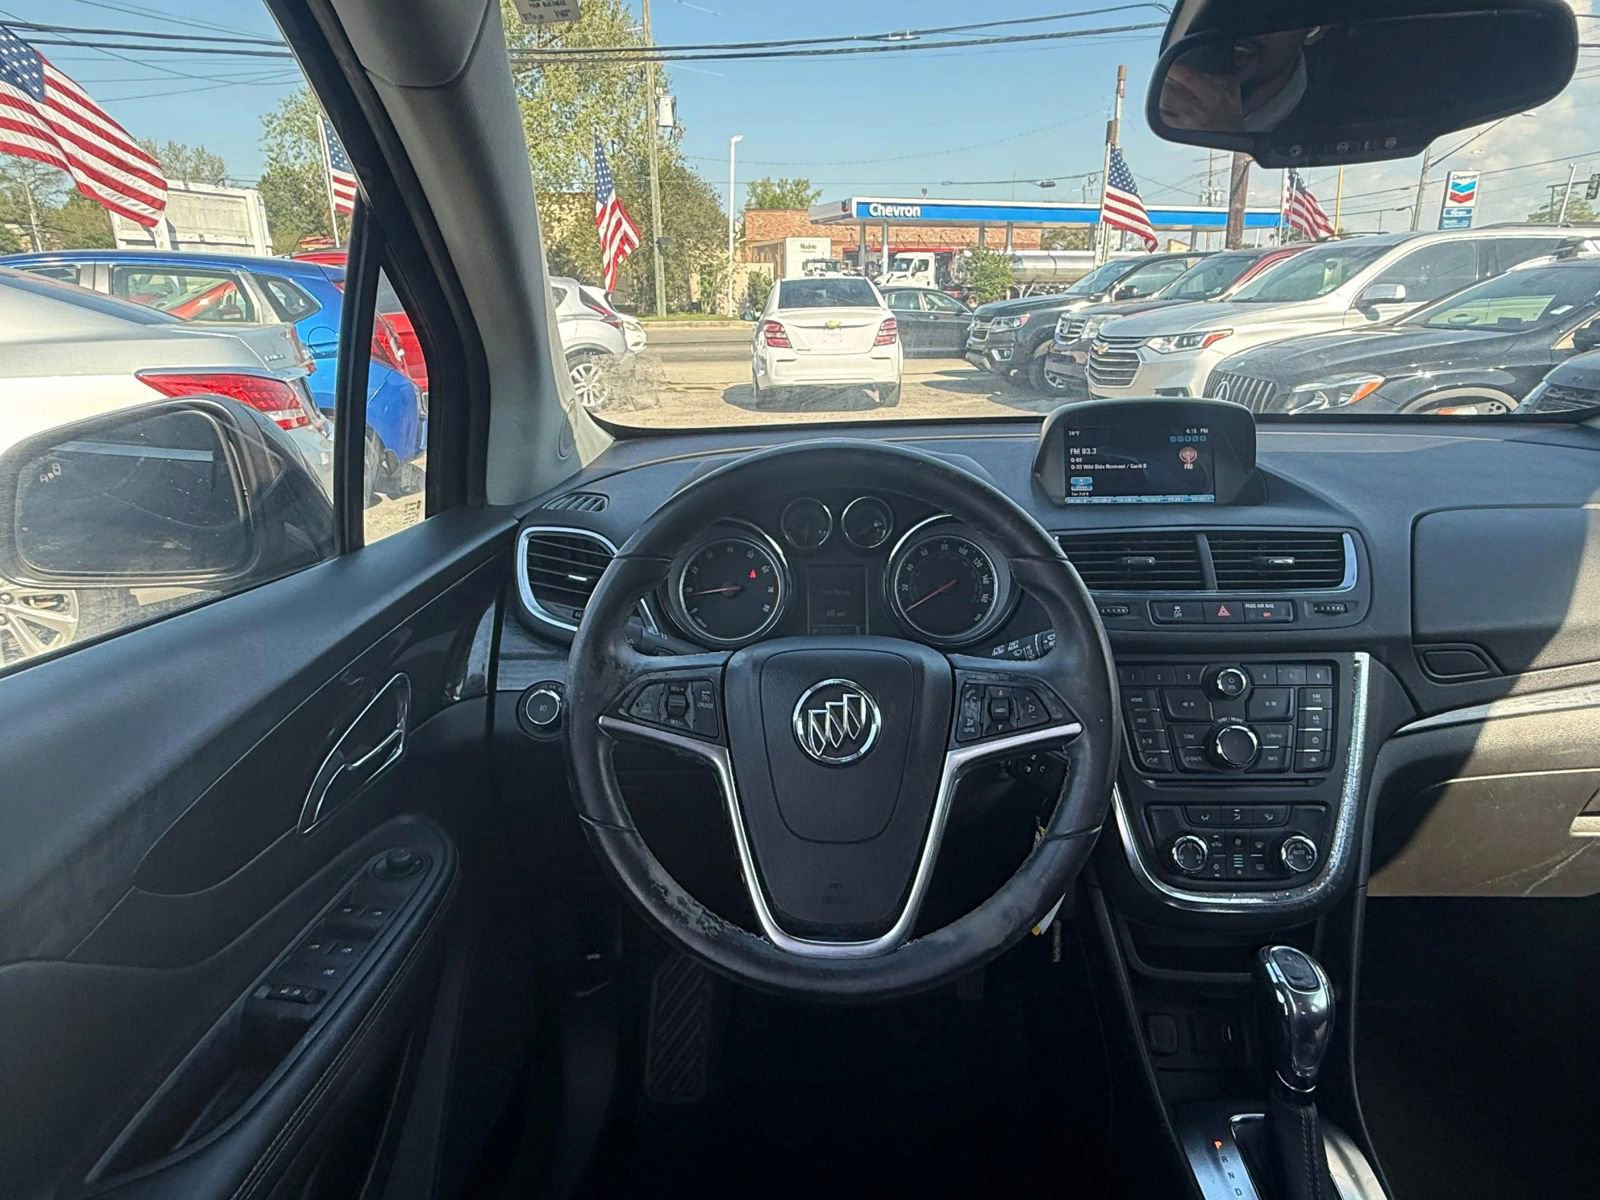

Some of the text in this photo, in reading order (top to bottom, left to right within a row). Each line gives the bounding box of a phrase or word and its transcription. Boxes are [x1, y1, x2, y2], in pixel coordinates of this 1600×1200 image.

[868, 203, 921, 218] Chevron
[1070, 447, 1080, 455] FM
[1214, 1140, 1222, 1149] P
[1221, 1155, 1229, 1164] R
[1227, 1172, 1236, 1180] N
[1234, 1188, 1242, 1196] D
